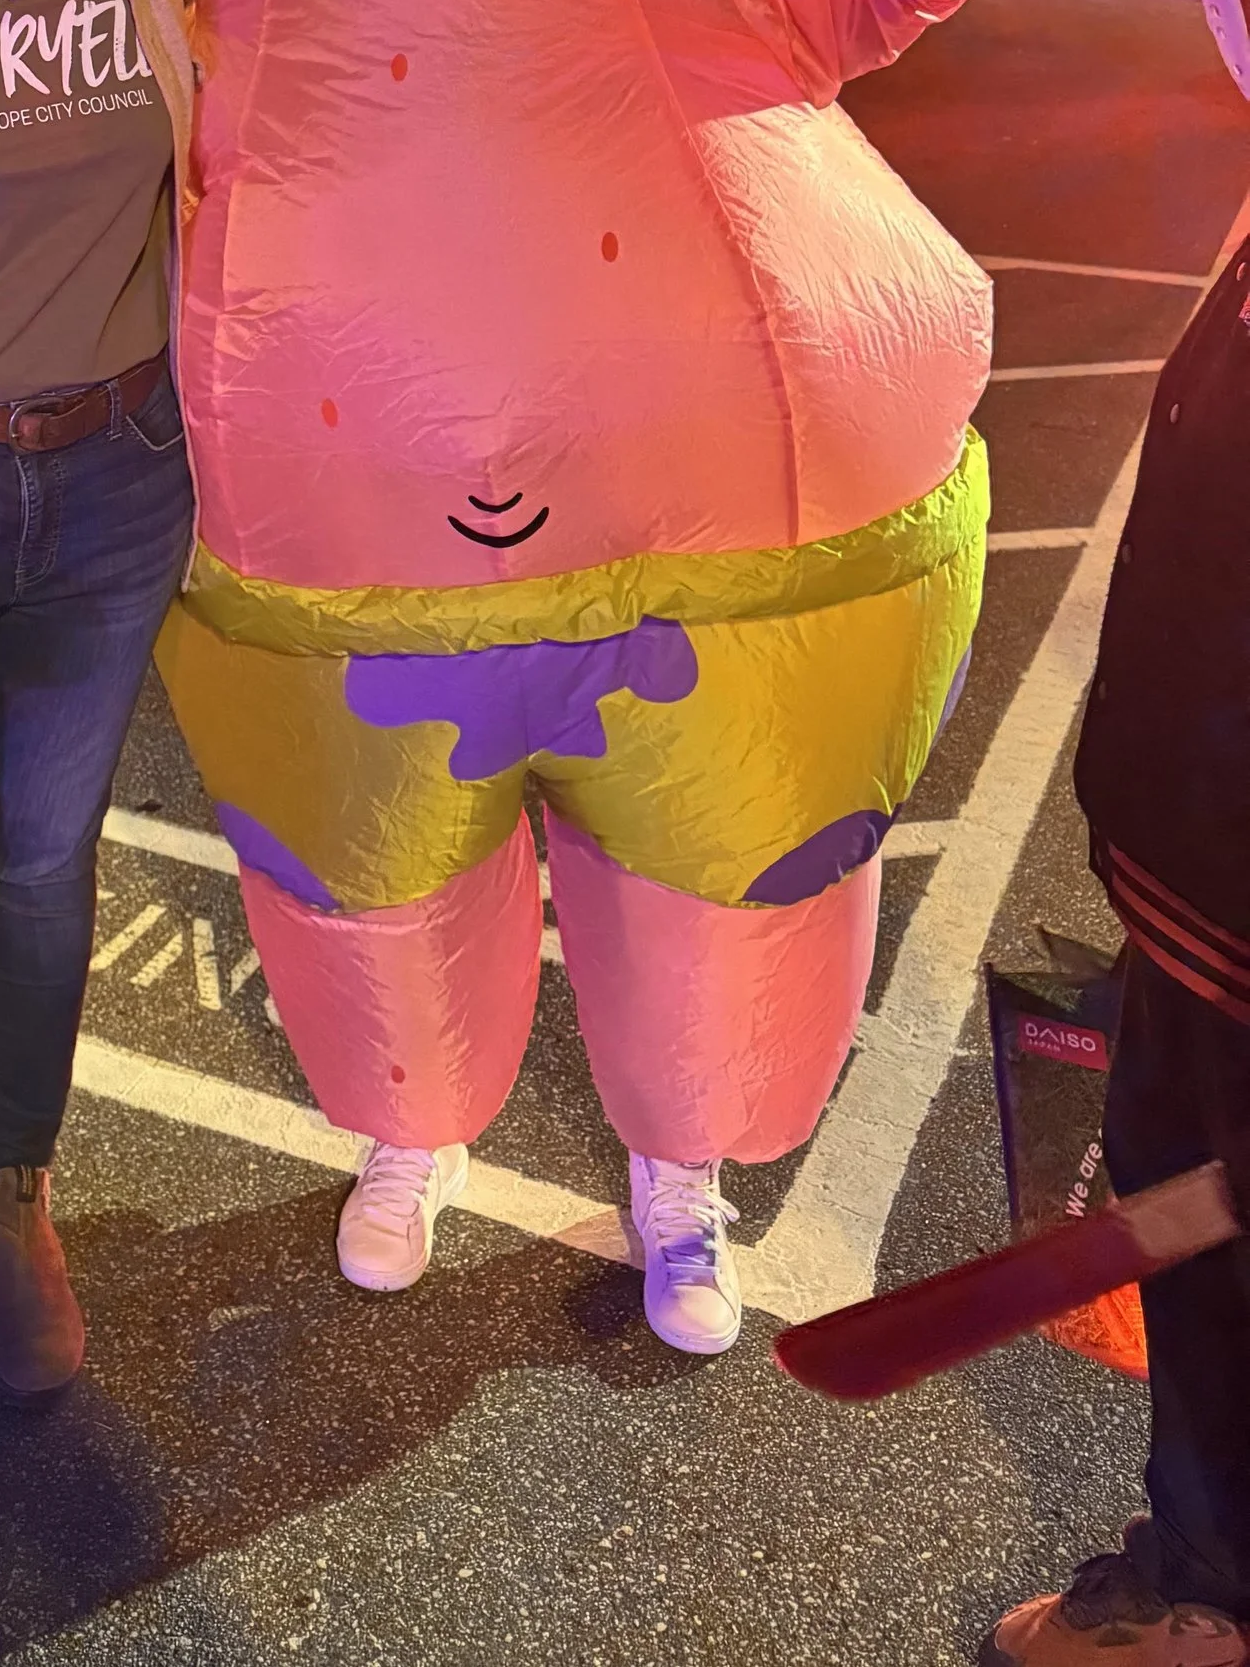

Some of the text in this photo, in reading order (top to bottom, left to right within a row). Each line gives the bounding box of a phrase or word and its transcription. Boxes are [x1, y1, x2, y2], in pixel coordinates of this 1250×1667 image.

[35, 101, 74, 123] CITY
[78, 89, 154, 115] COUNCIL
[1025, 1022, 1097, 1052] DAISO
[1065, 1142, 1103, 1218] We are
